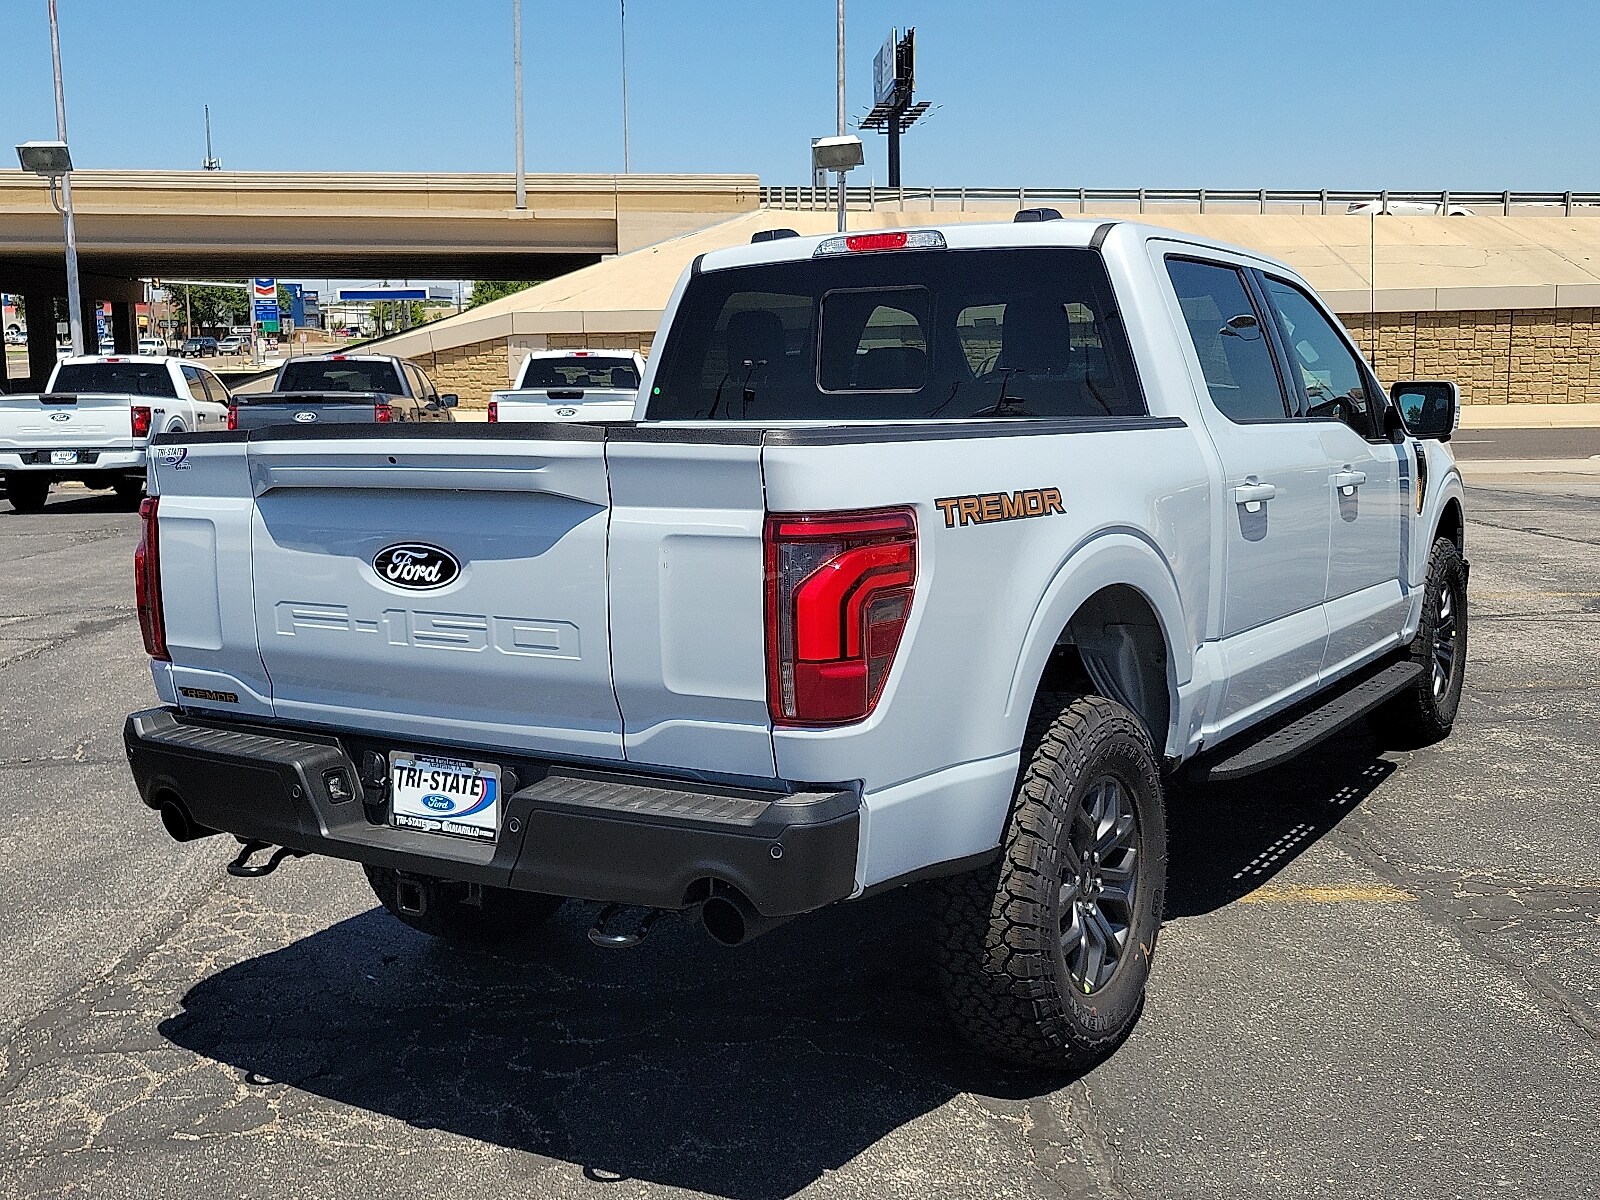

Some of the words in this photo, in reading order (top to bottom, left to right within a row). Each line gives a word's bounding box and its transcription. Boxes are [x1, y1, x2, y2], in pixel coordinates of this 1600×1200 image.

[934, 487, 1067, 528] TREMOR
[386, 551, 442, 583] Ford
[274, 600, 582, 661] F-150
[179, 686, 239, 703] TREMOR
[394, 766, 481, 796] TRI-STATE
[427, 797, 449, 809] Ford
